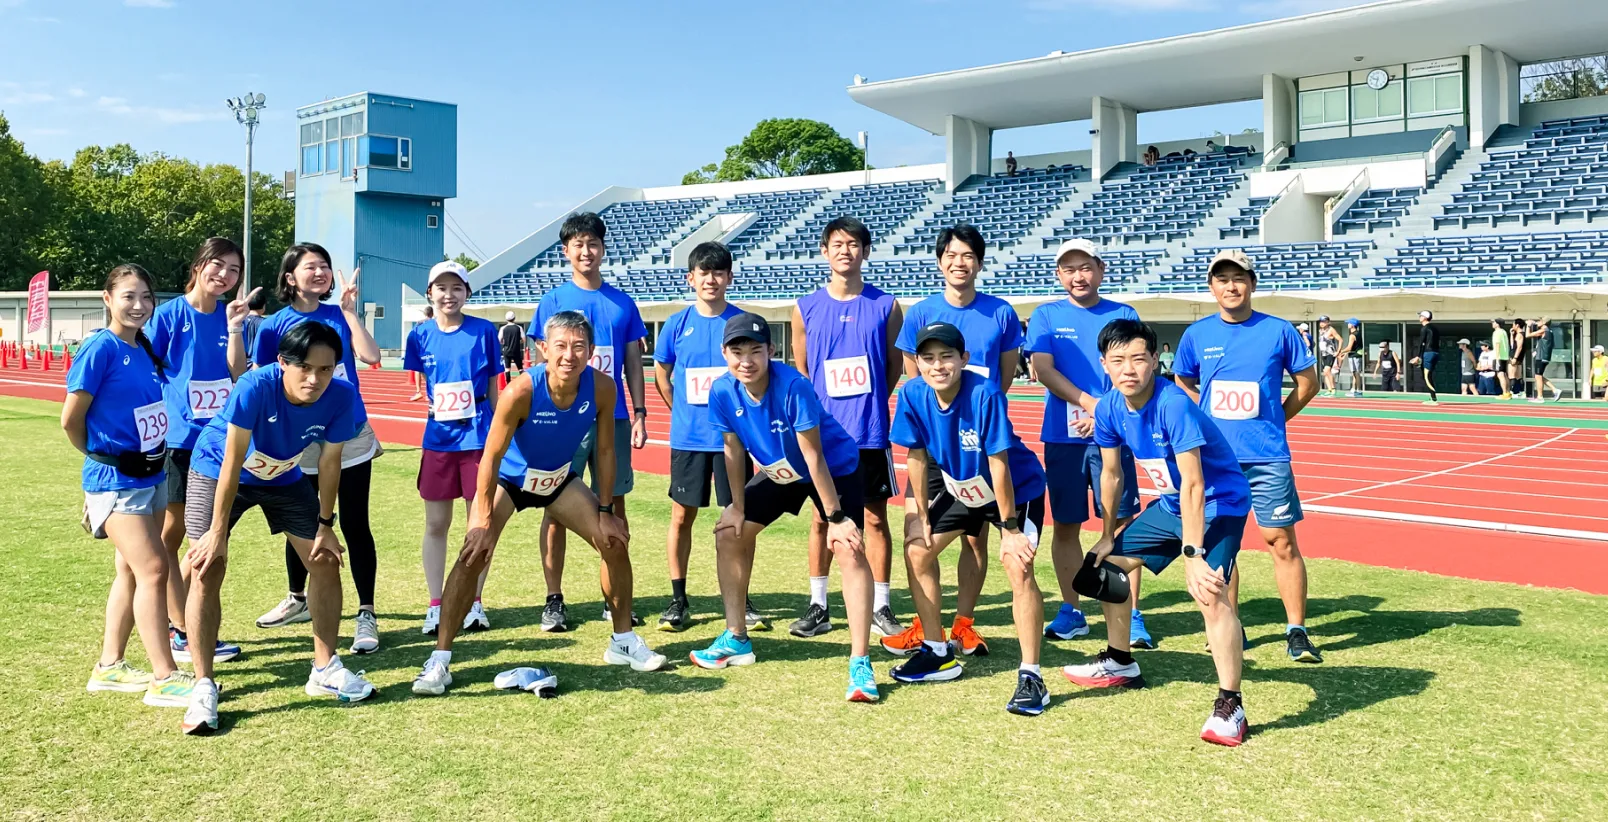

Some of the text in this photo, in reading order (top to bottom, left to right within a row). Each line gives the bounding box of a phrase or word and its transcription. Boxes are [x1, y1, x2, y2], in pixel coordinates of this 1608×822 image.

[31, 280, 45, 320] FINISH
[590, 354, 612, 374] 02
[692, 376, 720, 396] 14
[829, 365, 867, 389] 140
[192, 388, 230, 411] 223
[435, 390, 472, 412] 229
[1213, 389, 1255, 412] 200
[138, 411, 168, 442] 239
[529, 470, 566, 492] 196
[948, 482, 985, 502] 141
